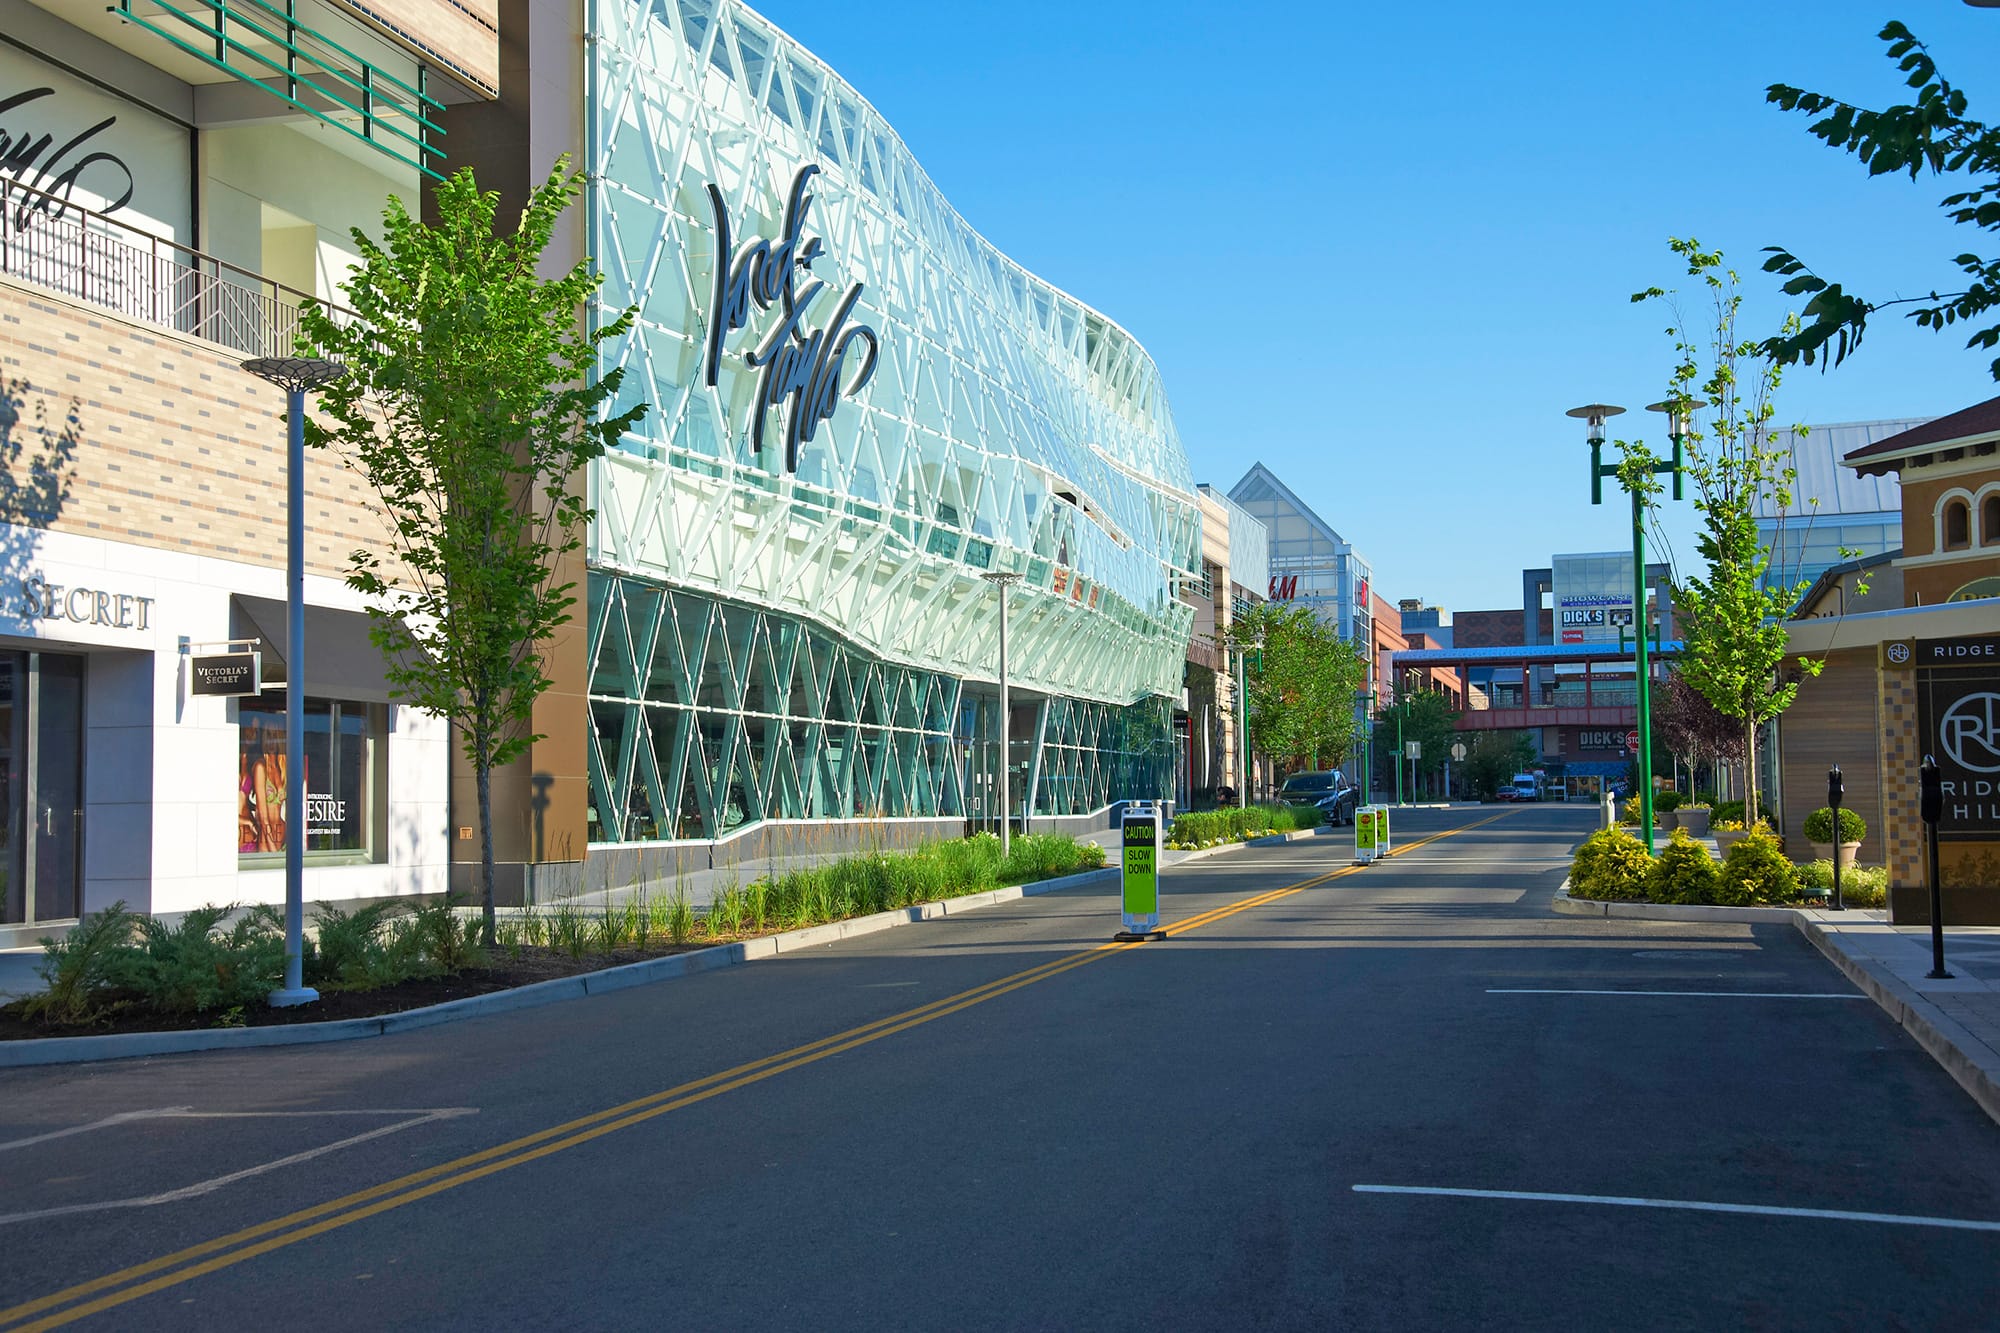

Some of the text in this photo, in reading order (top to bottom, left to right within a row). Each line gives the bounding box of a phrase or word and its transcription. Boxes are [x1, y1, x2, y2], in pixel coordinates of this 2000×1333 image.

[19, 576, 155, 631] SECRET
[1563, 611, 1603, 622] DICK'S
[1934, 645, 1995, 657] RIDGE
[197, 667, 248, 676] VICTORIA'S
[206, 676, 239, 684] SECRET
[1580, 732, 1625, 745] DICK'S
[1627, 736, 1639, 744] STO
[1941, 781, 2000, 796] RID
[307, 801, 346, 821] ESIRE
[1125, 825, 1154, 839] CAUTION
[1129, 850, 1150, 860] SLOW
[1129, 864, 1151, 874] DOWN
